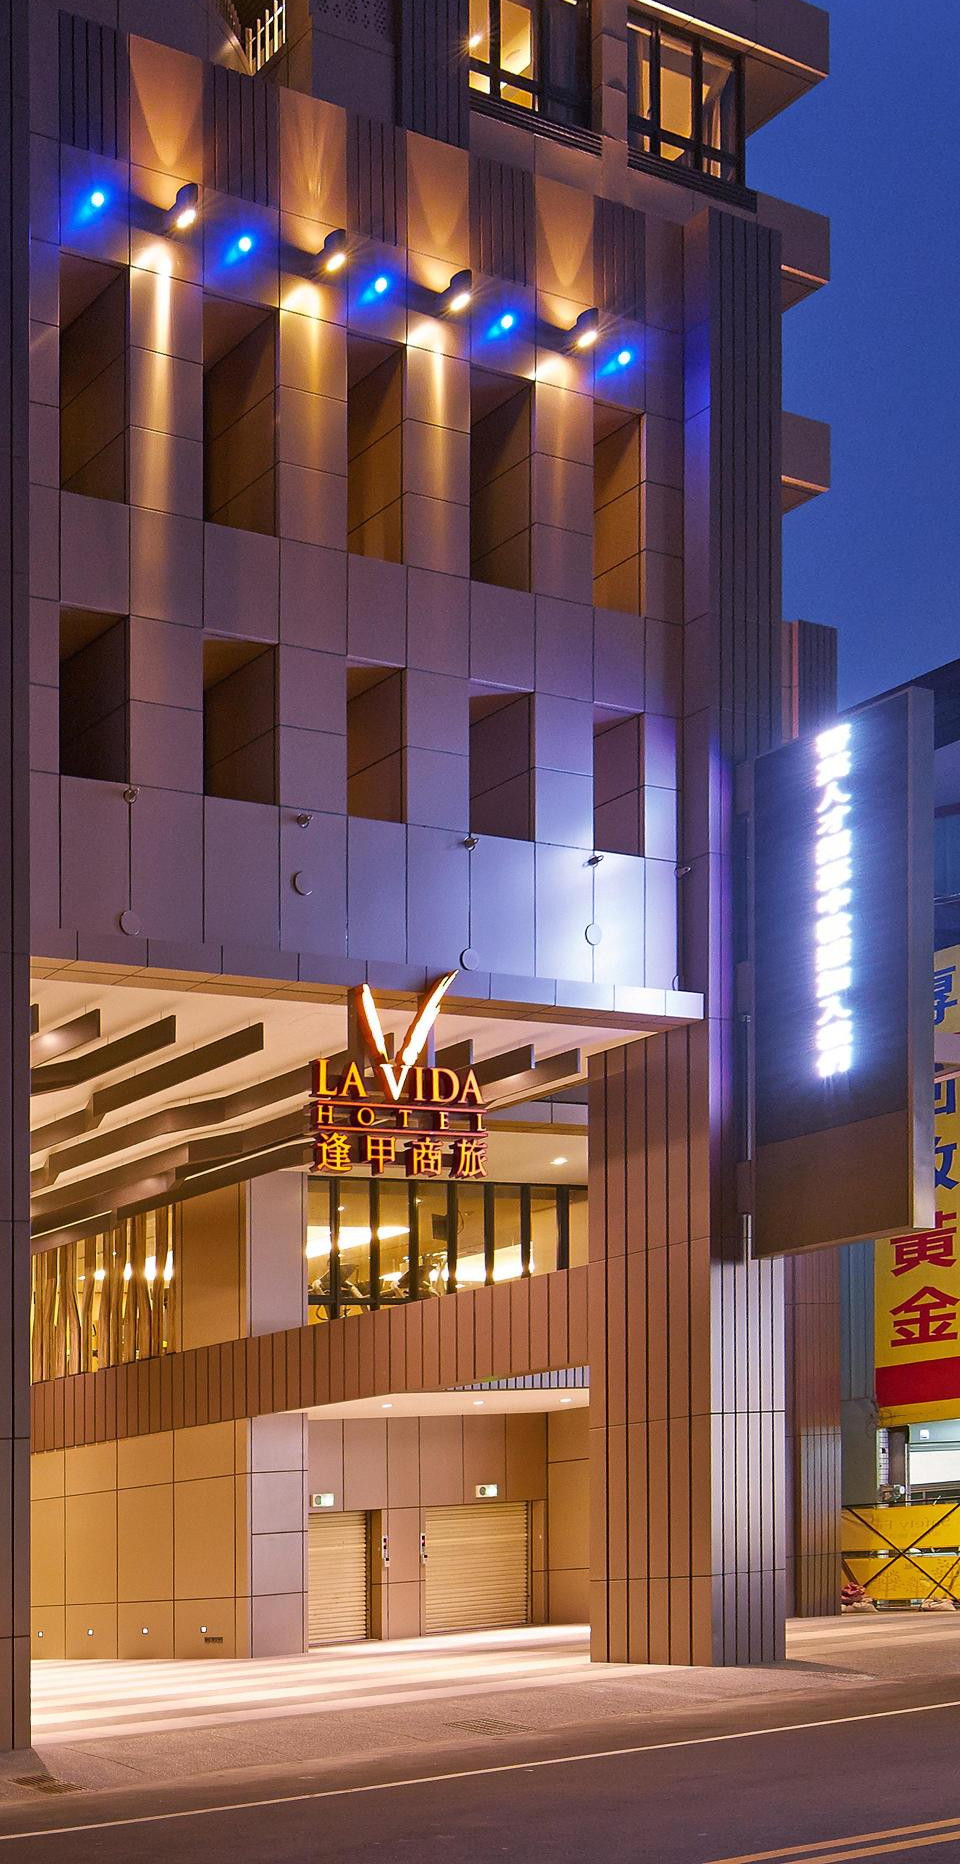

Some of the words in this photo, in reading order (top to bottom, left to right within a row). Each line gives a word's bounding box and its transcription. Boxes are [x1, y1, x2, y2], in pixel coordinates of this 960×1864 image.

[316, 1058, 368, 1098] LA
[316, 1104, 487, 1132] HOTEL
[317, 1132, 489, 1178] 逢甲商旅
